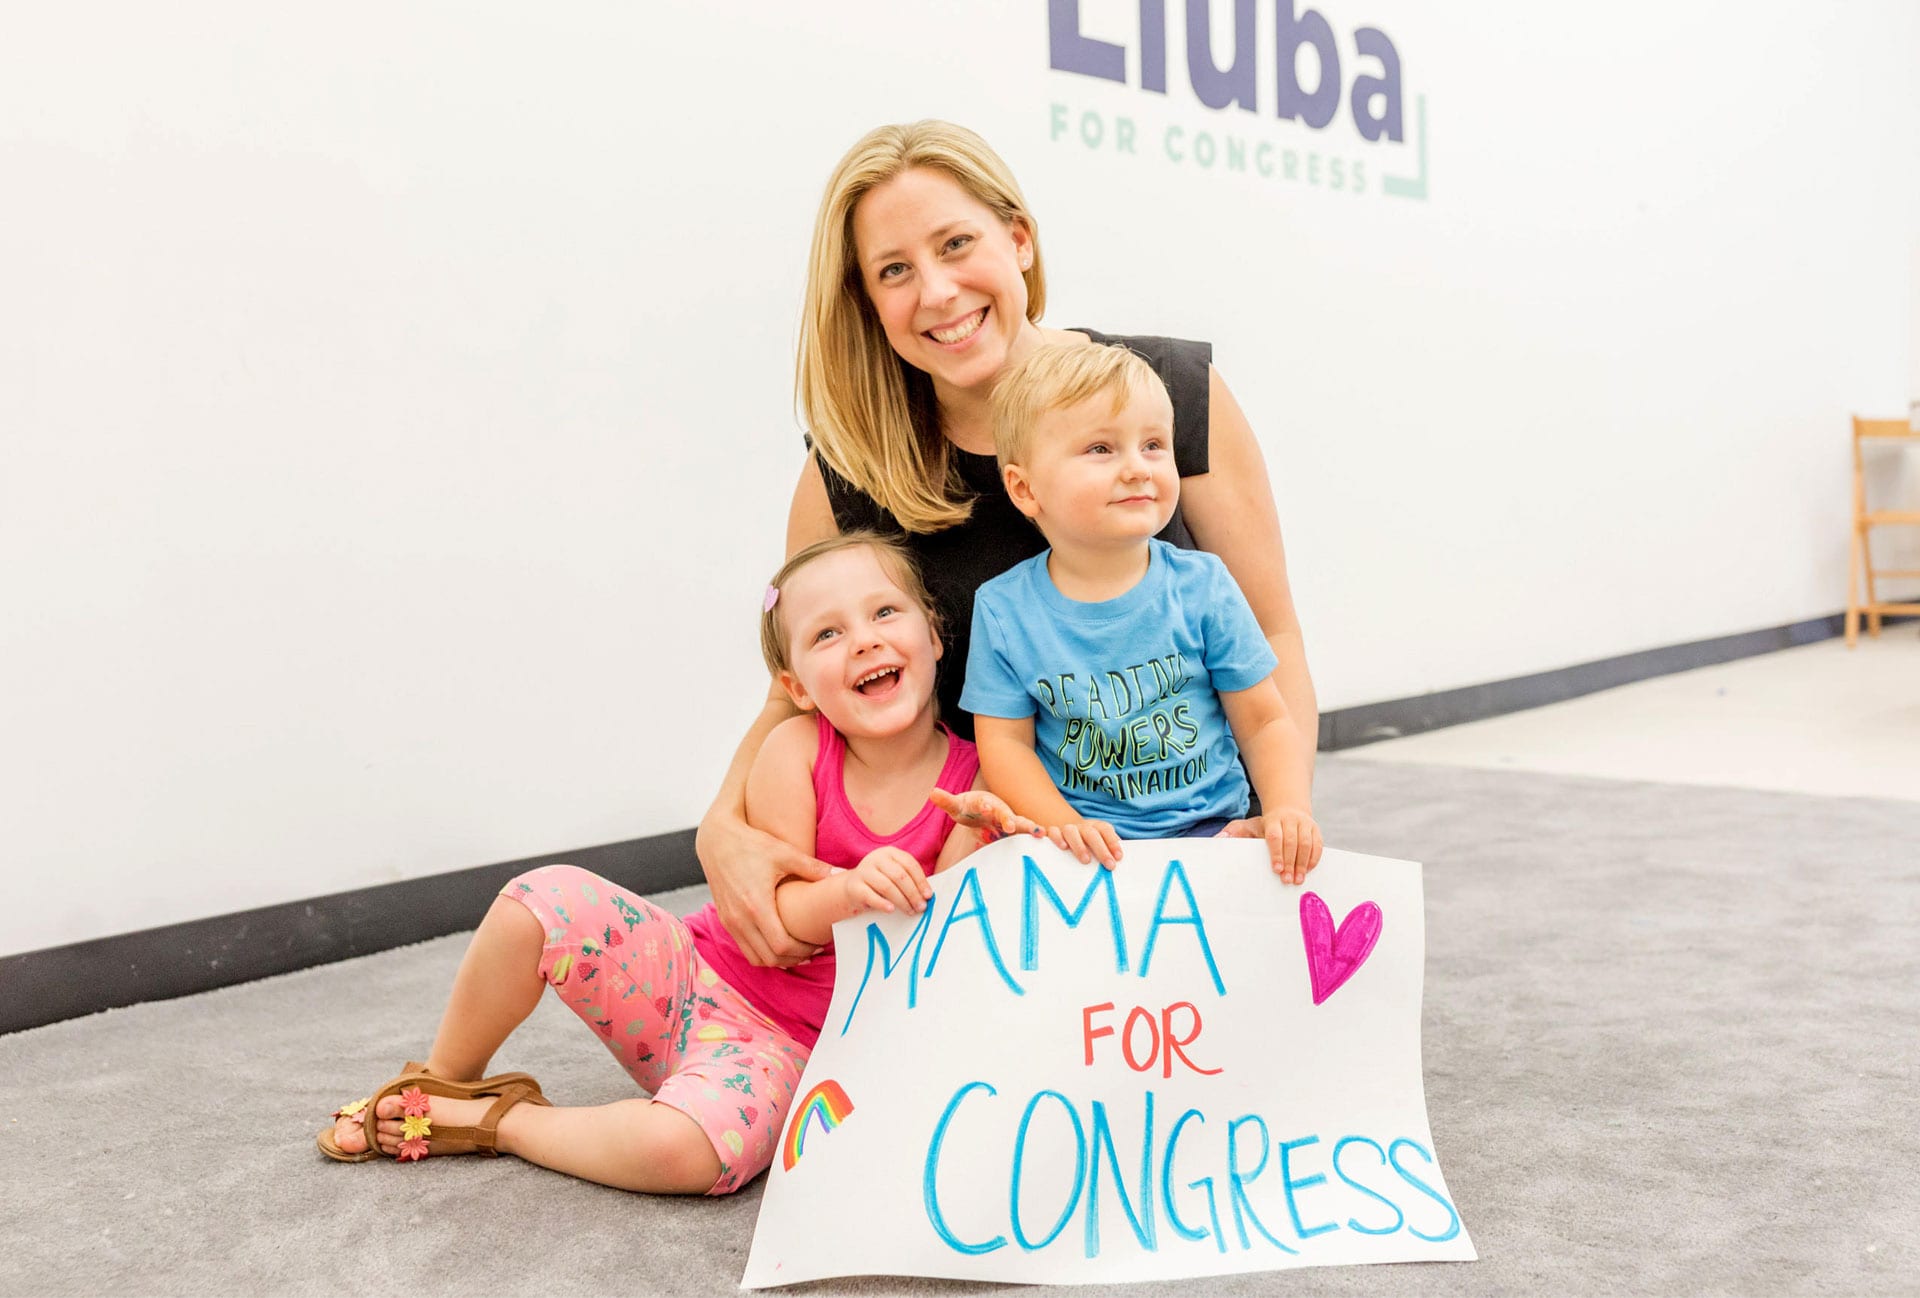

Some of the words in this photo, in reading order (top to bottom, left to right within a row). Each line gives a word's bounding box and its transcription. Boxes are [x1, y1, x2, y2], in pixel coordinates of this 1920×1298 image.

[1049, 102, 1138, 154] FOR
[1163, 125, 1368, 194] CONGRESS
[1037, 651, 1195, 721] READING
[1056, 698, 1200, 772] POWERS
[1061, 749, 1209, 801] IMAGINATION
[840, 854, 1228, 1037] MAMA
[1082, 1001, 1225, 1079] FOR
[922, 1081, 1462, 1259] CONGRESS
